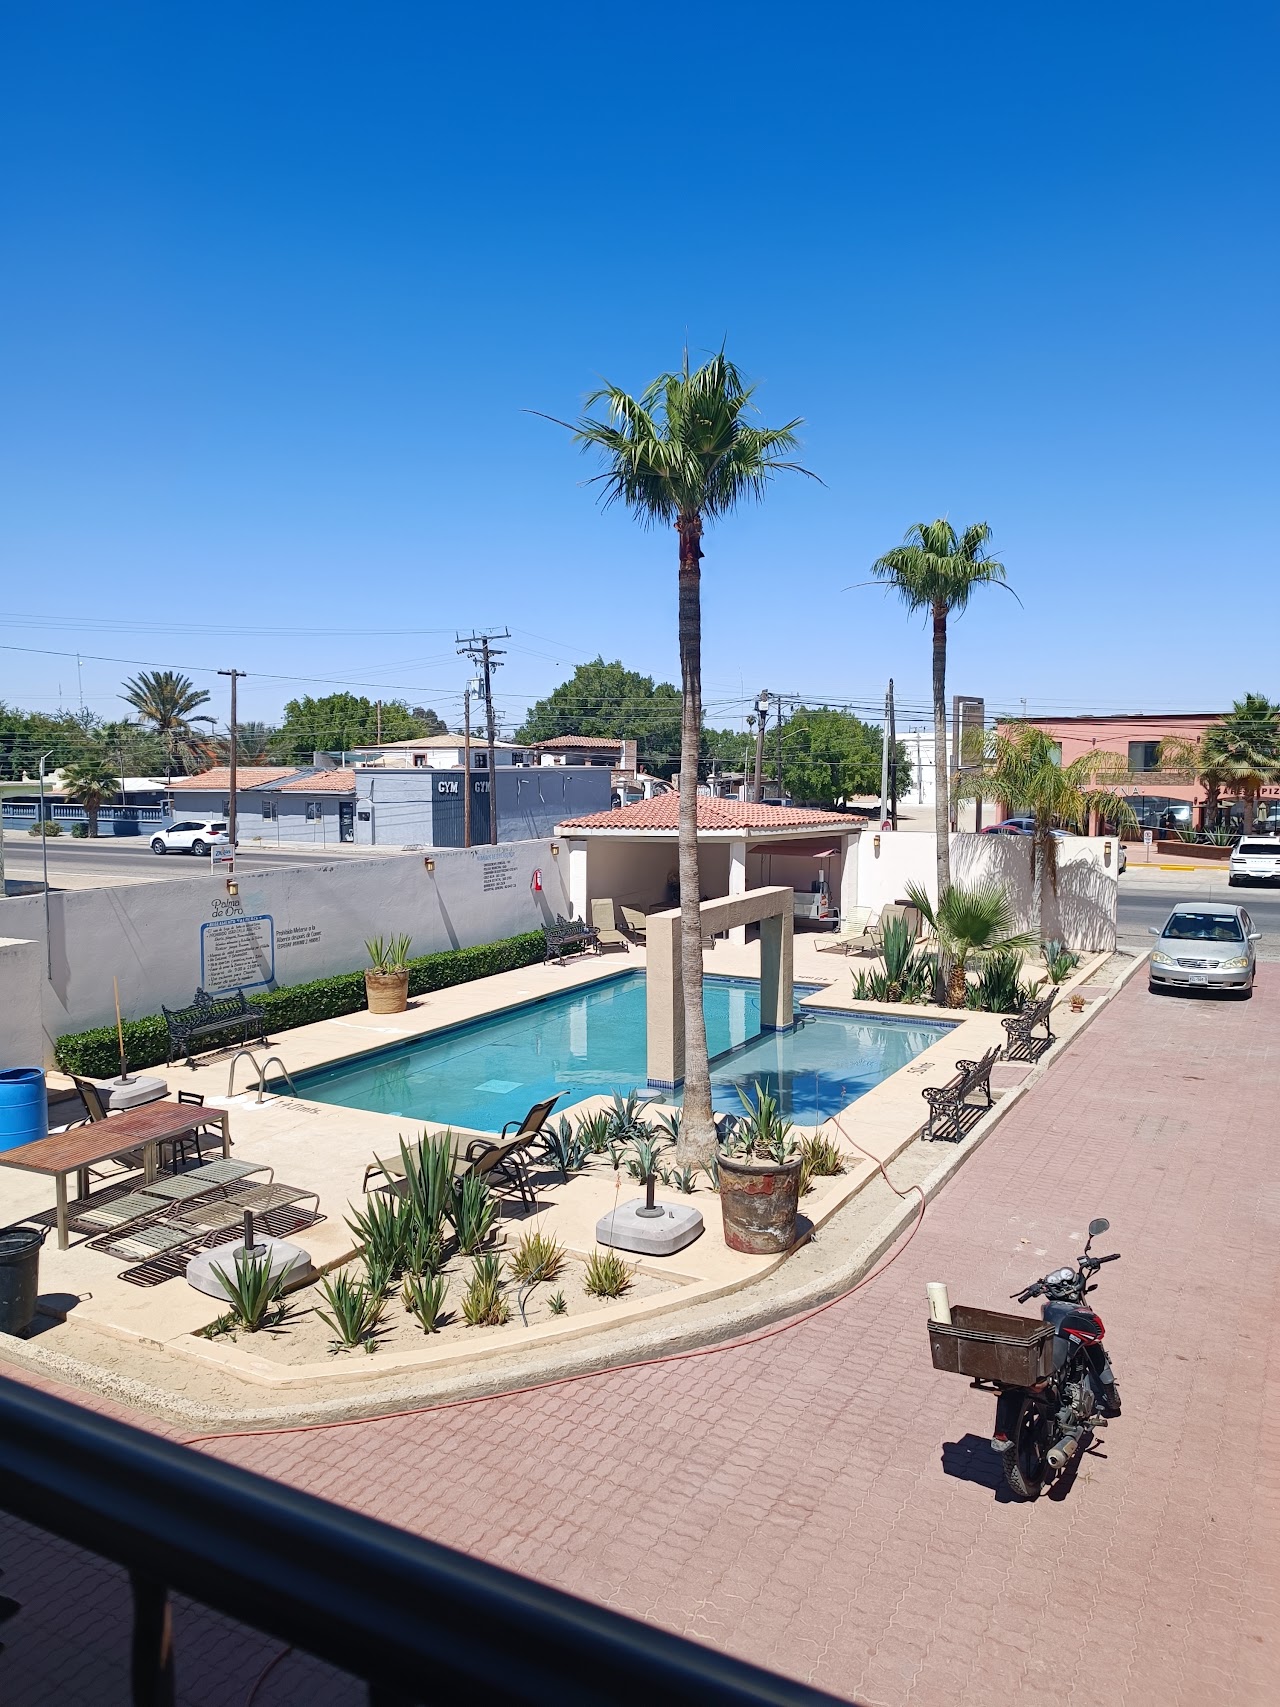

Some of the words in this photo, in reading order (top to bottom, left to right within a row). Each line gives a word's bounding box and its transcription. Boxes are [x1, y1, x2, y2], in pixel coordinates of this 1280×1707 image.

[438, 781, 459, 793] GYM
[211, 898, 240, 908] Palma
[212, 908, 224, 918] de
[225, 906, 244, 916] Oro
